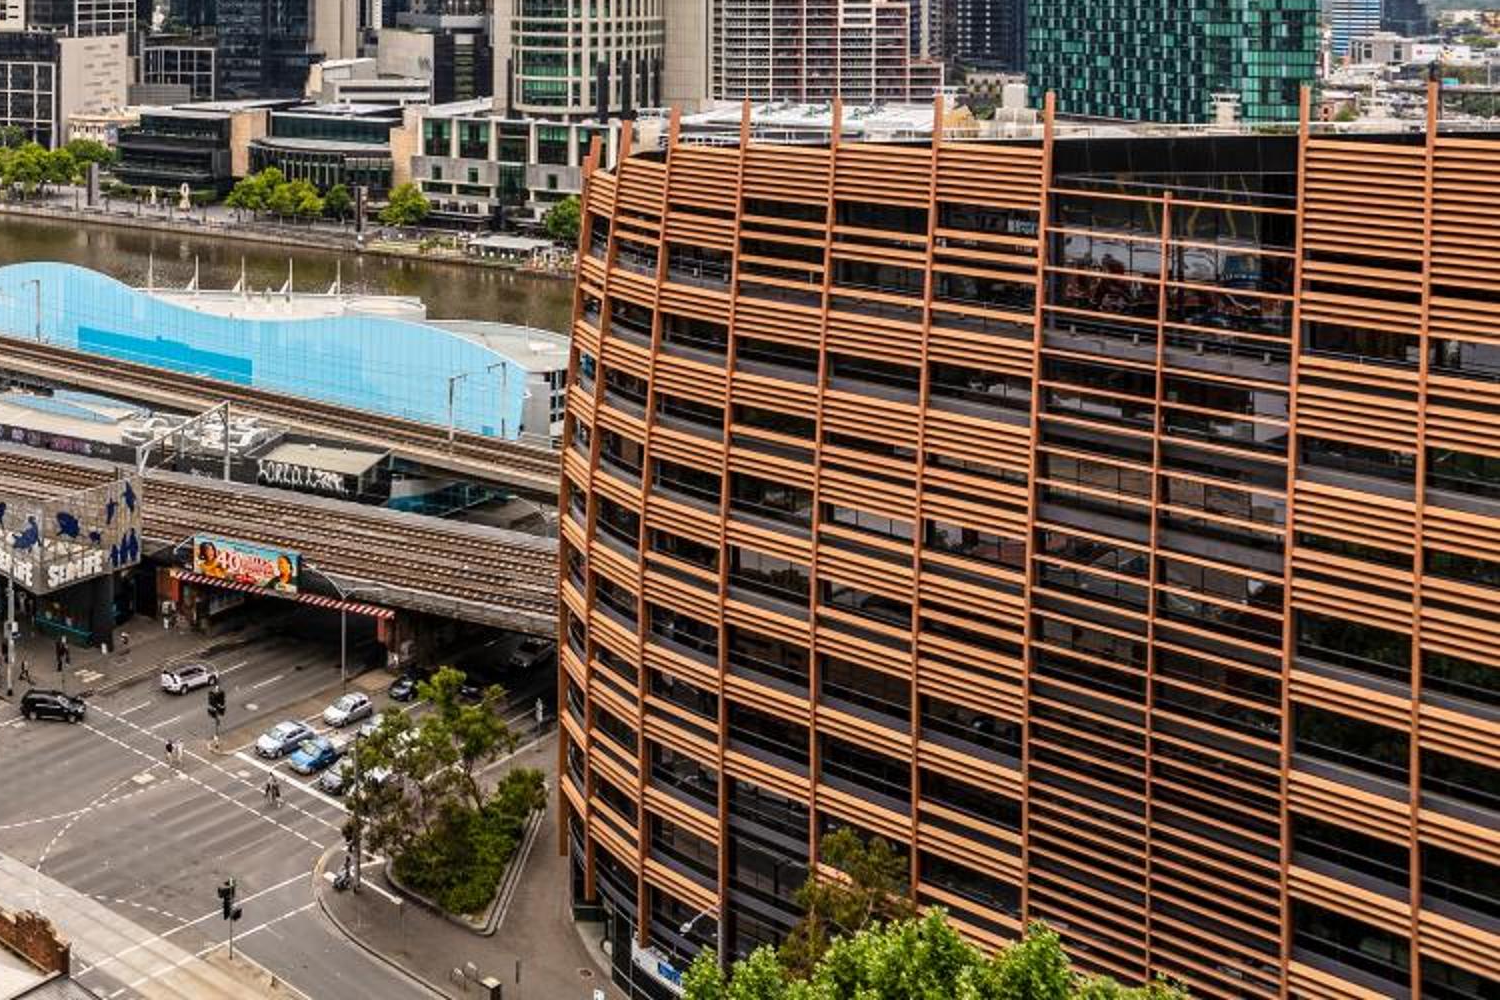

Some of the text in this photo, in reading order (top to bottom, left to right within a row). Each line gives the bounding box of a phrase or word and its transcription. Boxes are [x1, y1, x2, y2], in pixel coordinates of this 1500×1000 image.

[13, 557, 33, 587] LIFE
[47, 549, 104, 588] SEA LIFE
[217, 550, 241, 571] 40
